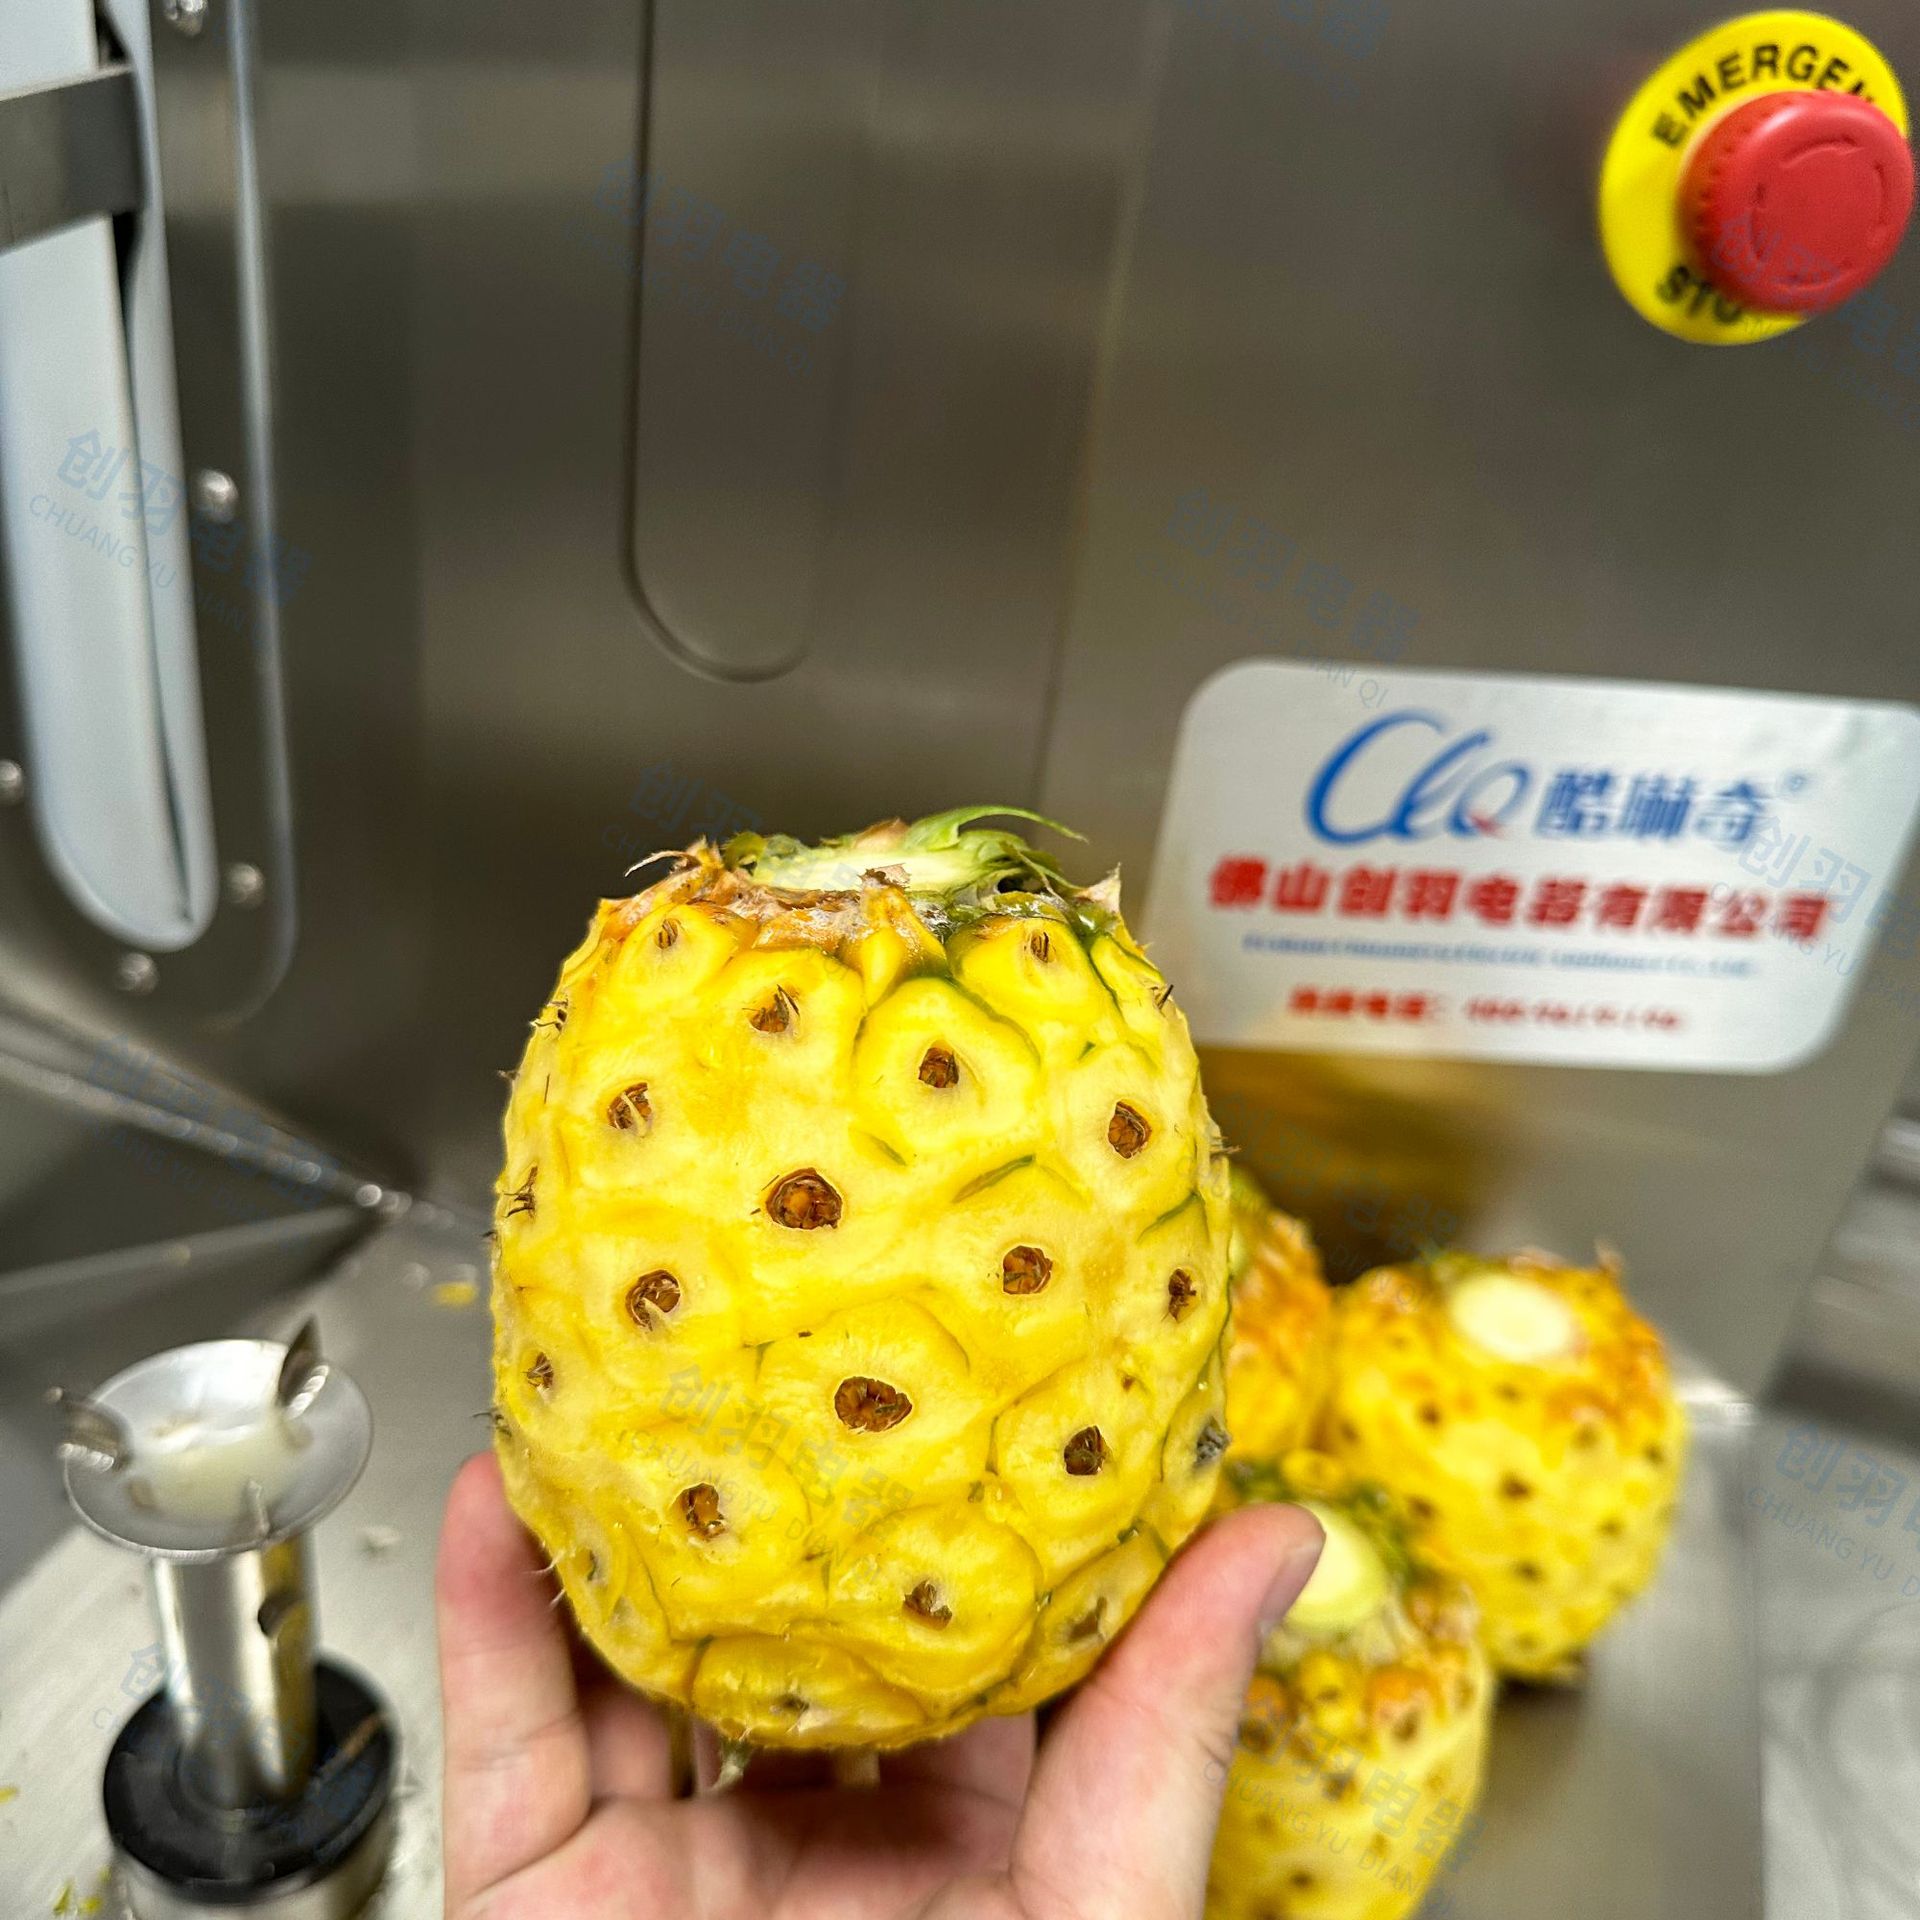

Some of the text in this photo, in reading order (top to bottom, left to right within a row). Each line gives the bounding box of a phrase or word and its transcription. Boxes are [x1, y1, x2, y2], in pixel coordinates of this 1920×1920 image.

[1208, 853, 1829, 941] 佛山创羽电器有限公司
